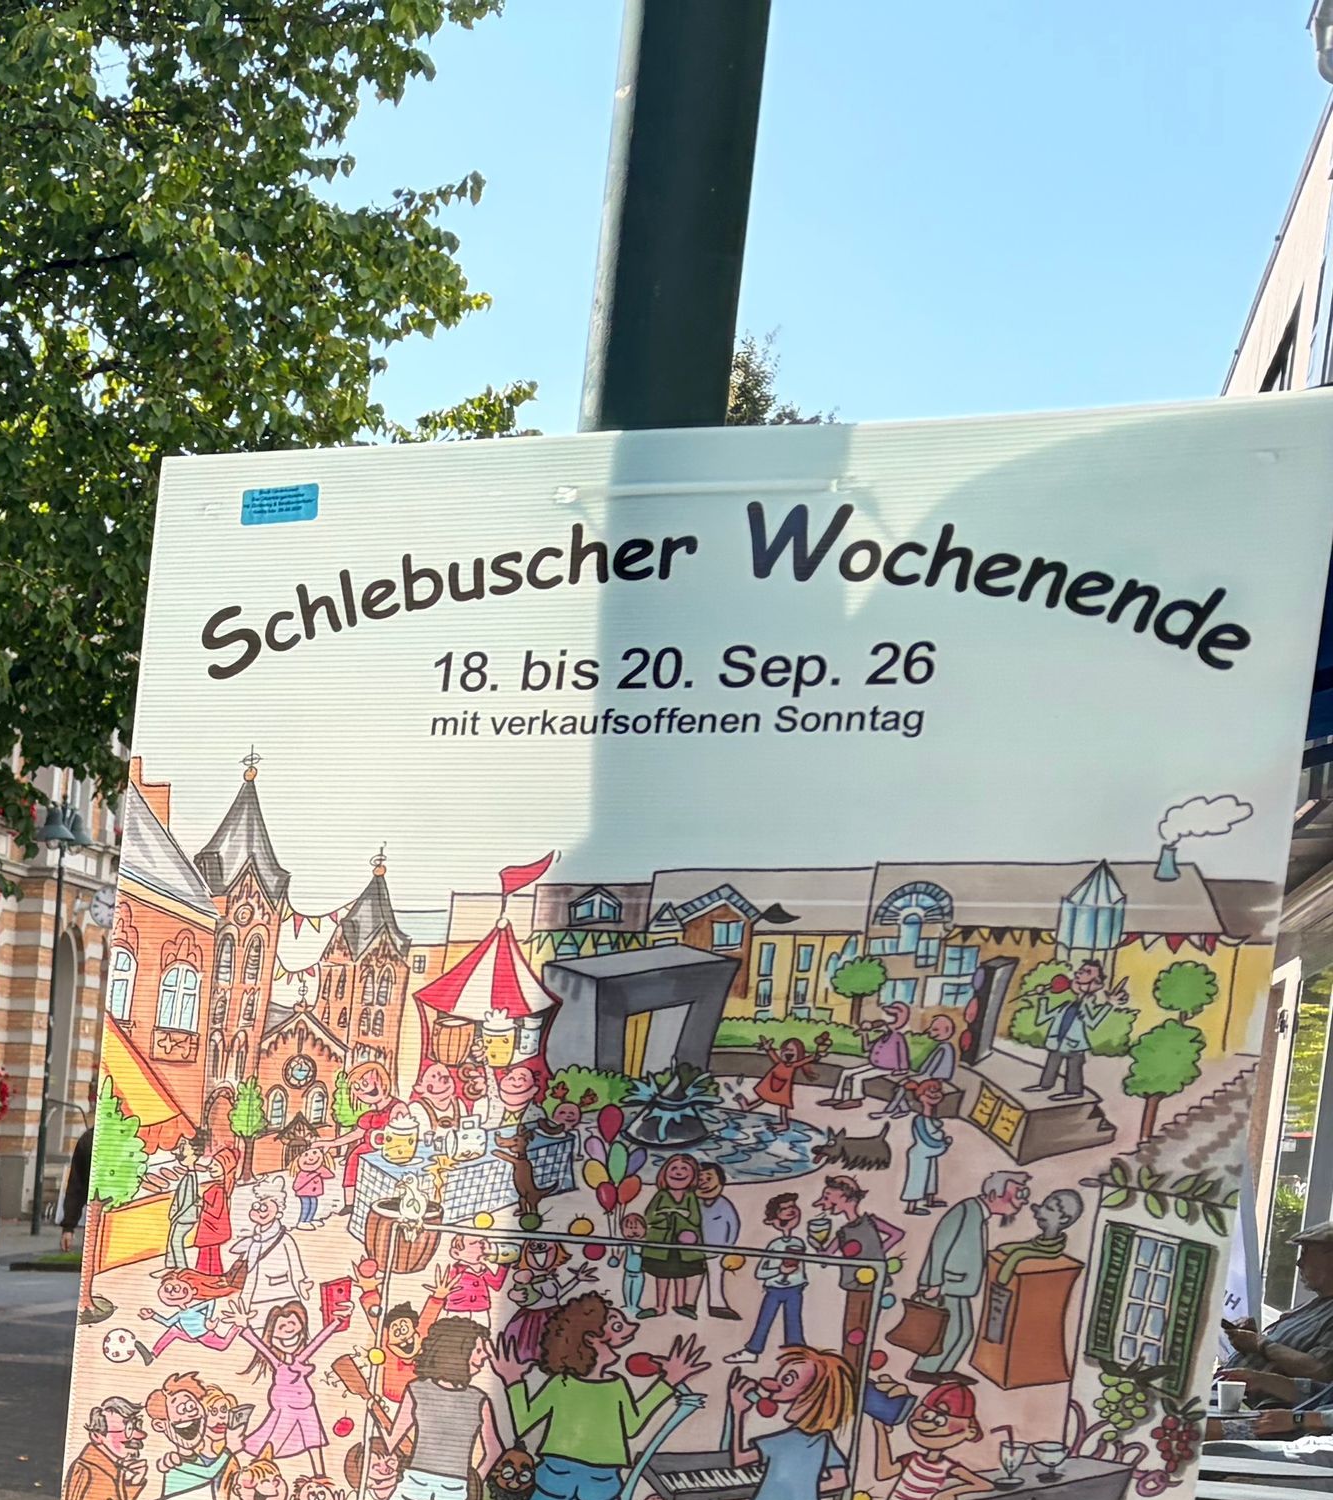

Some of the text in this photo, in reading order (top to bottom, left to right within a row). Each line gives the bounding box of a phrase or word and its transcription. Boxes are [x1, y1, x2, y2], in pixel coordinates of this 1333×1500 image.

[202, 502, 1251, 680] Schlebuscher Wochenende
[435, 640, 937, 697] 18. bis 20. Sep. 26
[431, 704, 926, 738] mit verkaufsoffenen Sonntag
